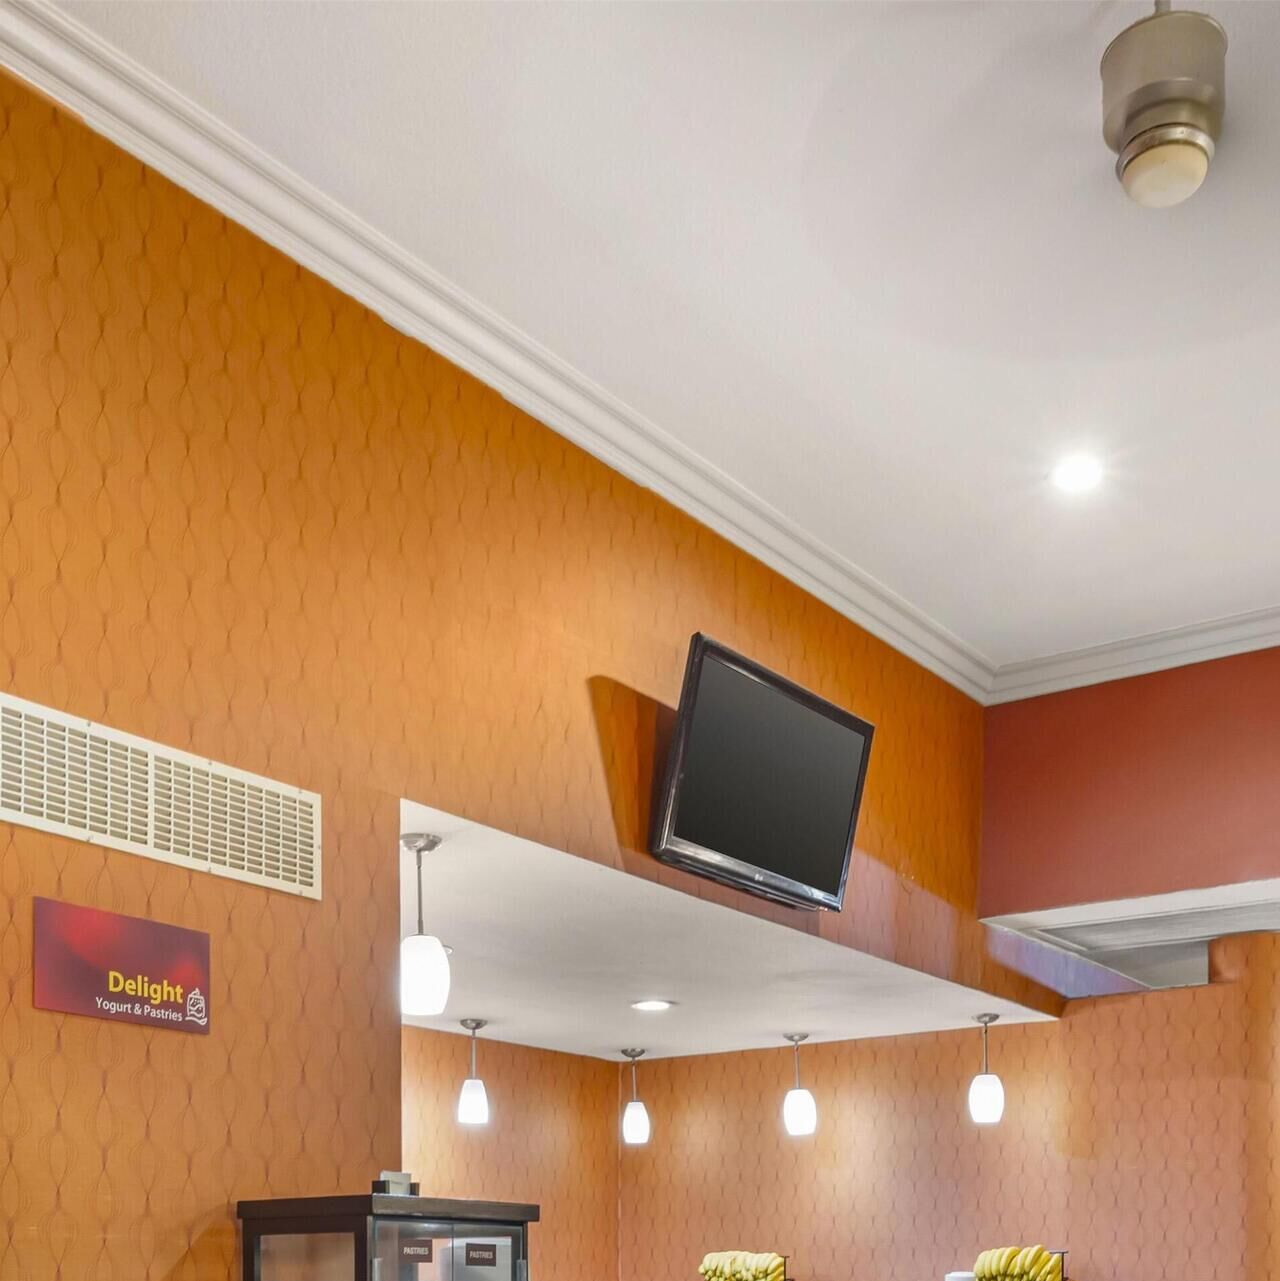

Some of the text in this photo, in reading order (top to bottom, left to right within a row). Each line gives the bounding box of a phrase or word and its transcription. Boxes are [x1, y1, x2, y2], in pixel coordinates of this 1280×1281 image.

[108, 970, 184, 1005] Delight
[96, 997, 183, 1022] Yogurt & Pastries
[403, 1246, 429, 1255] PASTRIES
[469, 1251, 493, 1259] PASTRIES
